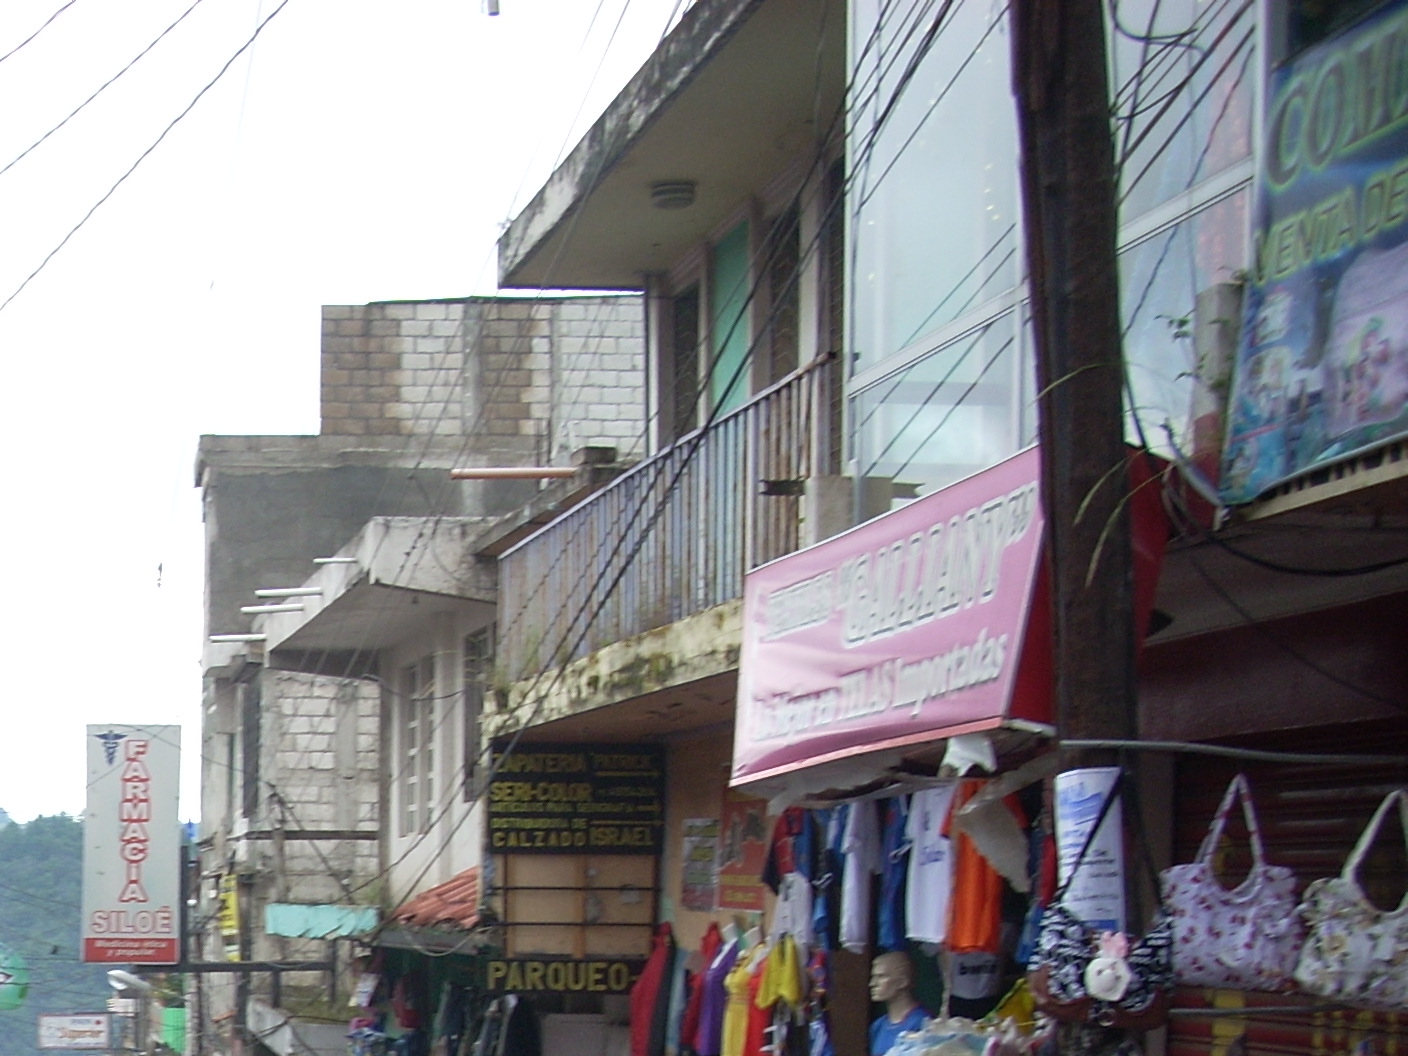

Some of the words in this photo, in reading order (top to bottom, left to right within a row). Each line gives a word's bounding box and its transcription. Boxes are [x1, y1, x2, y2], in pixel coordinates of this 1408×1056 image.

[491, 781, 592, 801] SERI-COLOR
[119, 739, 151, 903] FARMACIA
[492, 831, 587, 847] CALZADO
[92, 906, 172, 934] SILOÉ
[486, 961, 629, 991] PARQUEO
